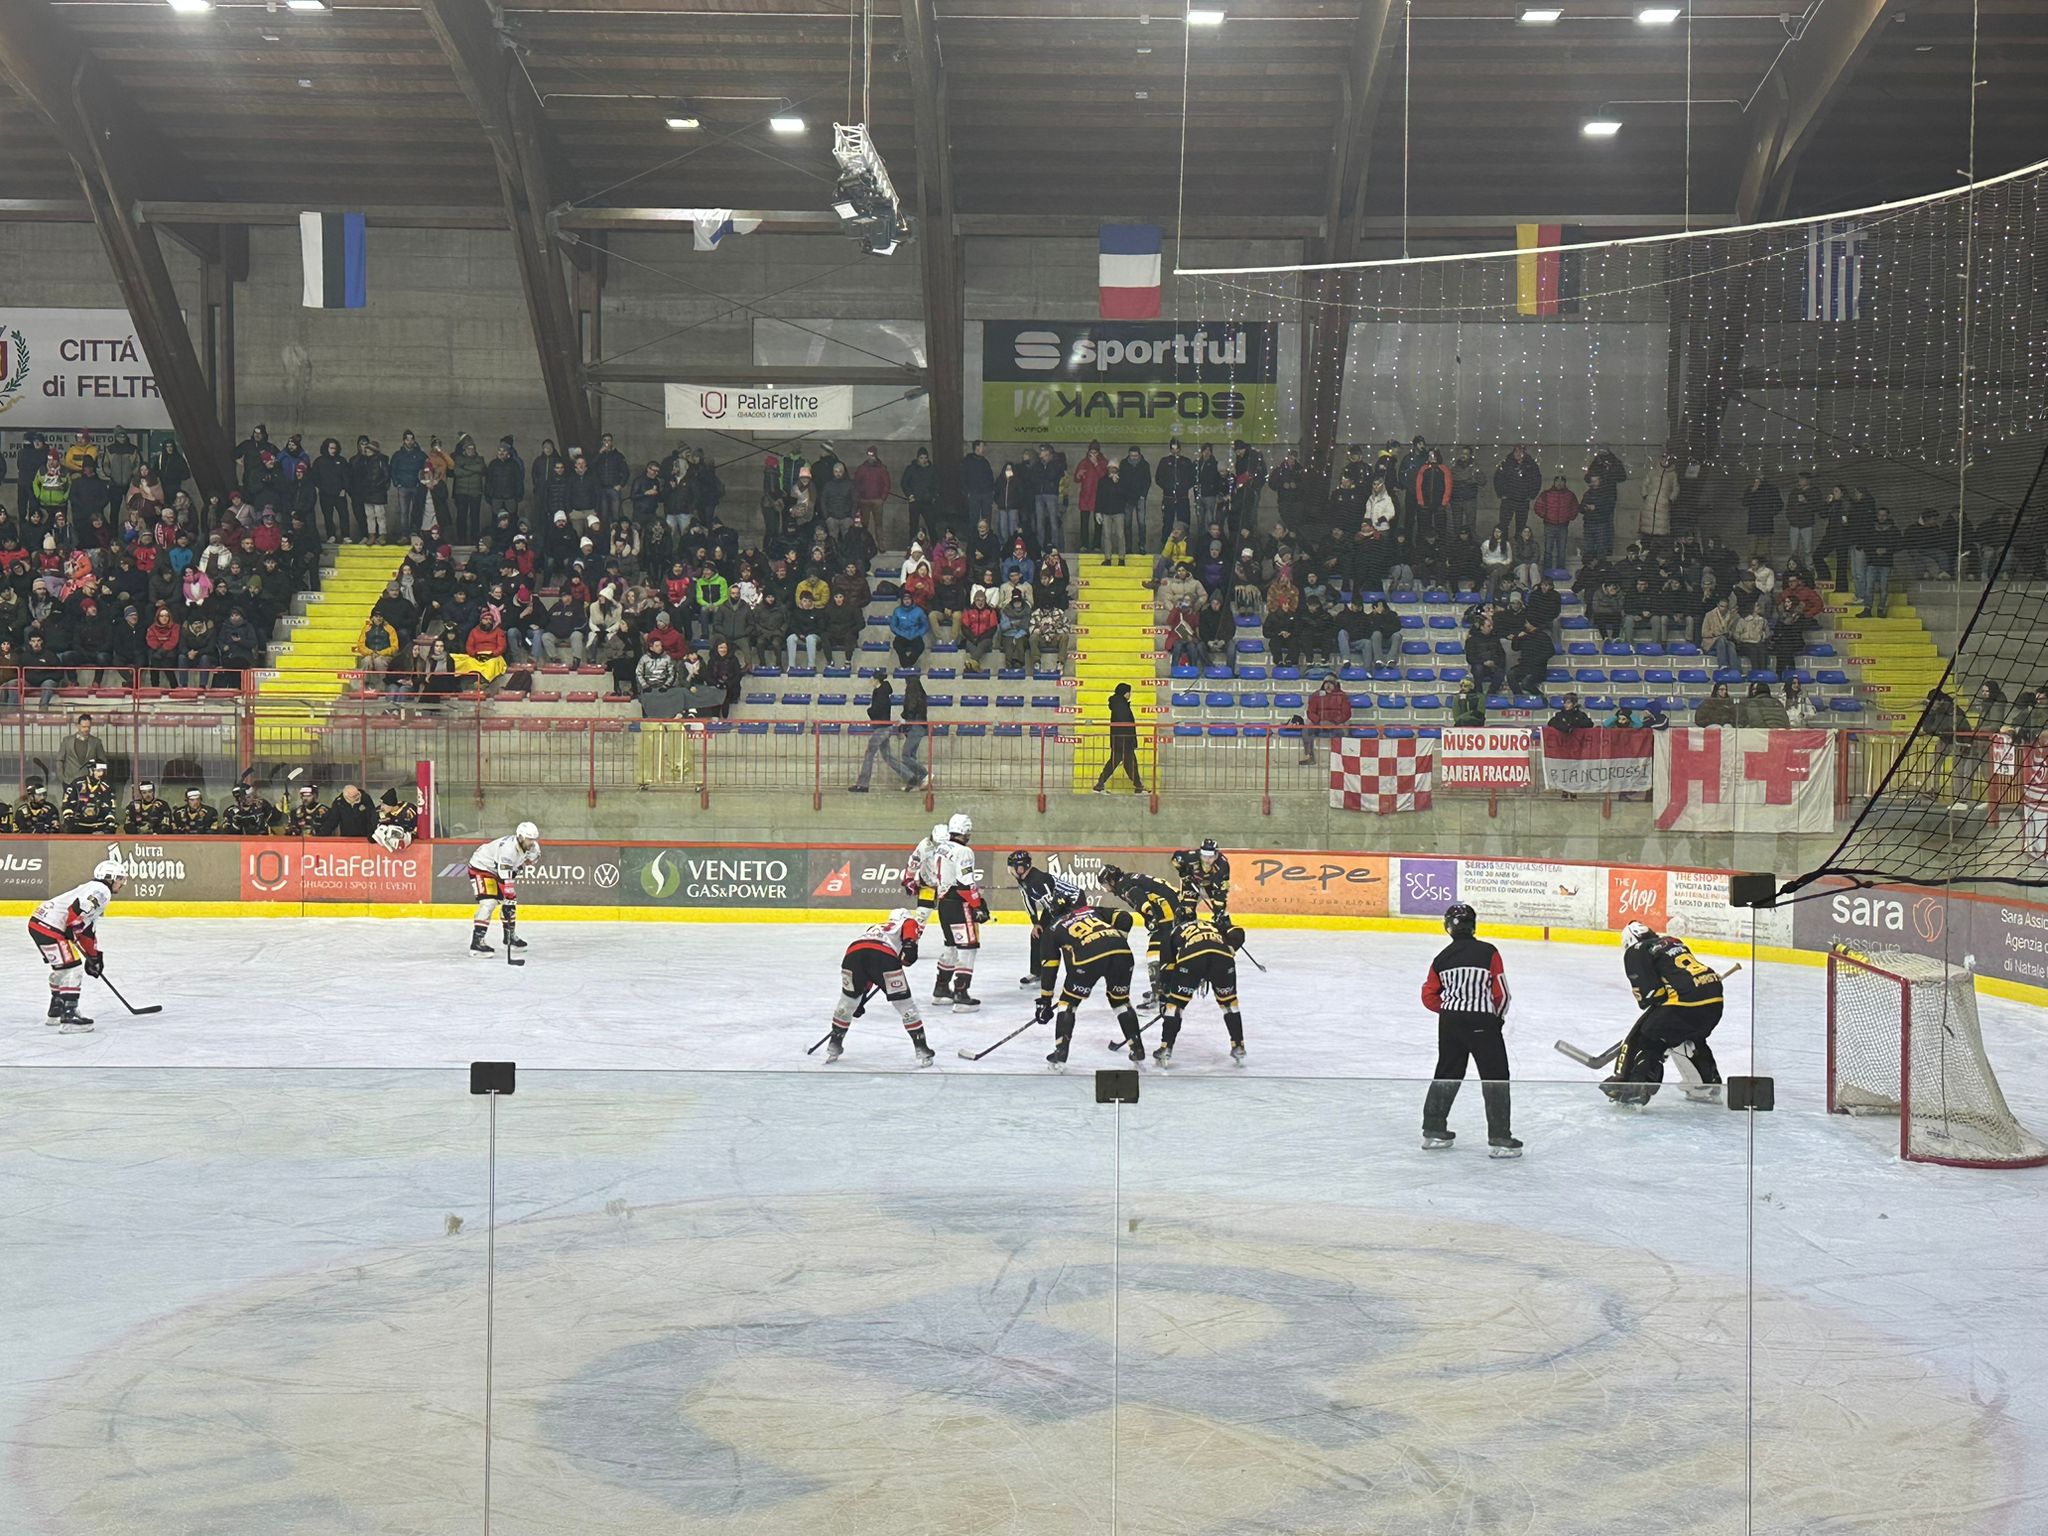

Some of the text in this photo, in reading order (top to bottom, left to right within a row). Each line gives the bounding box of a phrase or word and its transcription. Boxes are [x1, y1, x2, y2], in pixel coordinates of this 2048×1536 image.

[1071, 332, 1247, 371] sportful
[42, 375, 160, 398] di FELTR
[738, 393, 819, 410] PalaFeltre
[1443, 734, 1530, 751] MUSO DURO
[1441, 765, 1531, 783] BARETA FRACADA
[1550, 763, 1649, 784] BIANCOROSSI
[135, 843, 163, 857] birra
[301, 854, 417, 877] PalaFeltre
[690, 860, 788, 882] VENETO
[1074, 855, 1102, 868] birra
[1251, 858, 1382, 891] Pepe
[1615, 878, 1630, 887] THE
[1676, 873, 1692, 882] THE
[1693, 873, 1719, 883] SHOP
[134, 884, 165, 897] 1897
[300, 880, 343, 889] GHIACCIO
[386, 882, 416, 890] EVENTI
[687, 883, 787, 899] GAS&POWER
[1619, 879, 1657, 915] shop
[1831, 894, 1904, 931] sara
[2001, 908, 2024, 925] Sara
[1068, 917, 1112, 939] 94
[2005, 932, 2043, 952] Agenzia
[2003, 957, 2046, 978] di Natale
[1616, 1044, 1629, 1075] CCM
